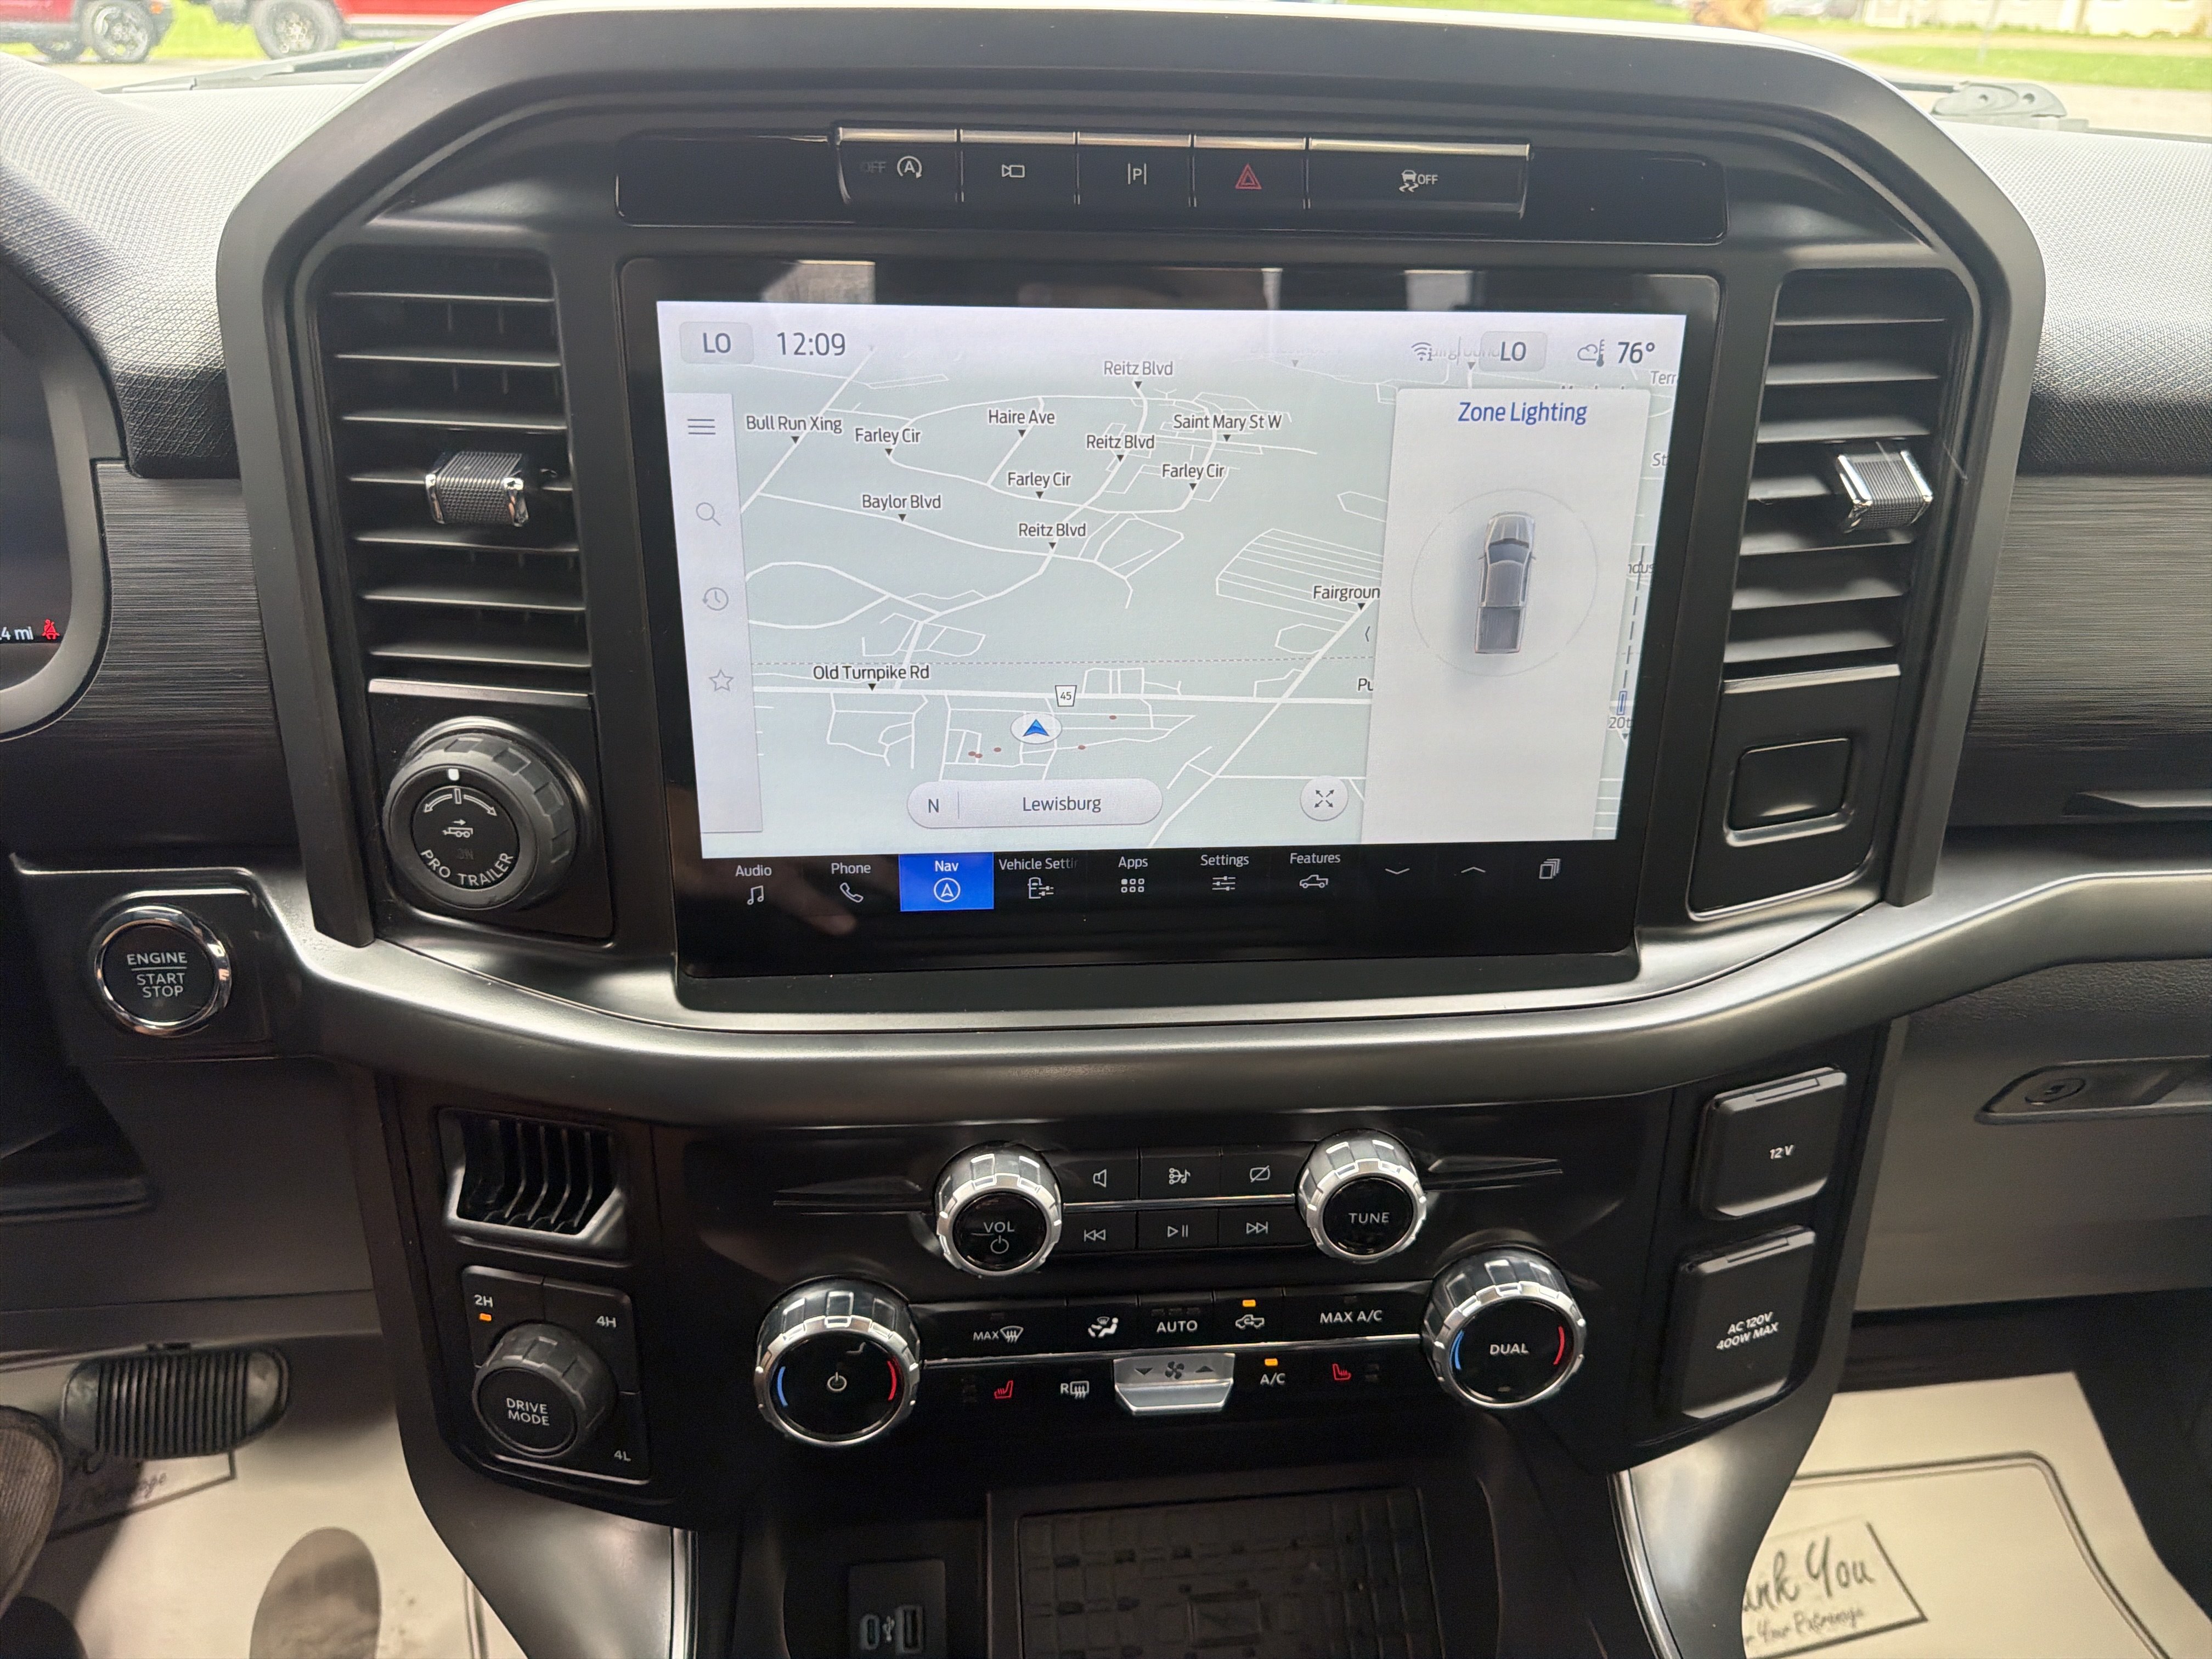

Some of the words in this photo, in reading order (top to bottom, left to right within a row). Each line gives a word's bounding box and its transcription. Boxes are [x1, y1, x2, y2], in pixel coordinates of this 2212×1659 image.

[1417, 173, 1438, 185] OFF
[702, 332, 731, 354] LO
[777, 332, 846, 356] 12:09
[1500, 341, 1527, 362] LO
[1617, 341, 1655, 364] 76°
[1104, 360, 1139, 376] Reitz
[1142, 360, 1173, 376] Blvd
[988, 409, 1025, 424] Haire
[1028, 410, 1056, 424] Ave
[1458, 401, 1506, 422] Zone
[1510, 401, 1588, 426] Lighting
[747, 415, 776, 431] Bull
[778, 416, 807, 431] Run
[810, 416, 842, 434] Xing
[1173, 414, 1209, 429] Saint
[1212, 415, 1246, 431] Mary
[1249, 414, 1265, 429] St
[1268, 415, 1282, 428] W
[855, 427, 899, 445] Farley
[902, 427, 921, 443] Cir
[1086, 435, 1121, 449] Reitz
[1124, 435, 1155, 449] Blvd
[1162, 464, 1204, 479] Farley
[1206, 464, 1224, 478] Cir
[1007, 471, 1051, 488] Farley
[1053, 472, 1071, 486] Cir
[862, 494, 907, 511] Baylor
[910, 494, 941, 509] Blvd
[1019, 523, 1053, 537] Reitz
[1056, 523, 1086, 537] Blvd
[14, 626, 33, 640] mi
[813, 665, 839, 680] Old
[842, 665, 906, 681] Turnpike
[910, 665, 929, 679] Rd
[1060, 691, 1072, 701] 45
[928, 798, 939, 813] N
[1023, 796, 1102, 813] Lewisburg
[935, 860, 959, 872] Nav
[998, 857, 1042, 871] Vehicle
[1118, 856, 1148, 870] Apps
[1200, 854, 1250, 867] Settings
[1290, 853, 1341, 865] Features
[420, 849, 452, 878] PRO
[458, 851, 514, 887] TRAILER
[735, 864, 772, 877] Audio
[831, 862, 872, 874] Phone
[126, 952, 188, 966] ENGINE
[137, 972, 185, 986] START
[143, 985, 184, 998] STOP
[1348, 1211, 1391, 1226] TUNE
[983, 1220, 1015, 1234] VOL
[474, 1294, 493, 1308] 2H
[596, 1315, 617, 1328] 4H
[1319, 1311, 1352, 1324] MAX
[1357, 1309, 1383, 1323] A/C
[1727, 1321, 1745, 1335] AC
[1746, 1311, 1774, 1329] 120V
[1156, 1320, 1198, 1333] AUTO
[973, 1330, 999, 1342] MAX
[1716, 1331, 1752, 1351] 400W
[1752, 1322, 1779, 1339] MAX
[1489, 1342, 1530, 1356] DUAL
[1260, 1373, 1285, 1386] A/C
[506, 1397, 549, 1415] DRIVE
[507, 1409, 550, 1426] MODE
[613, 1450, 631, 1463] 4L
[1805, 1536, 1876, 1599] You
